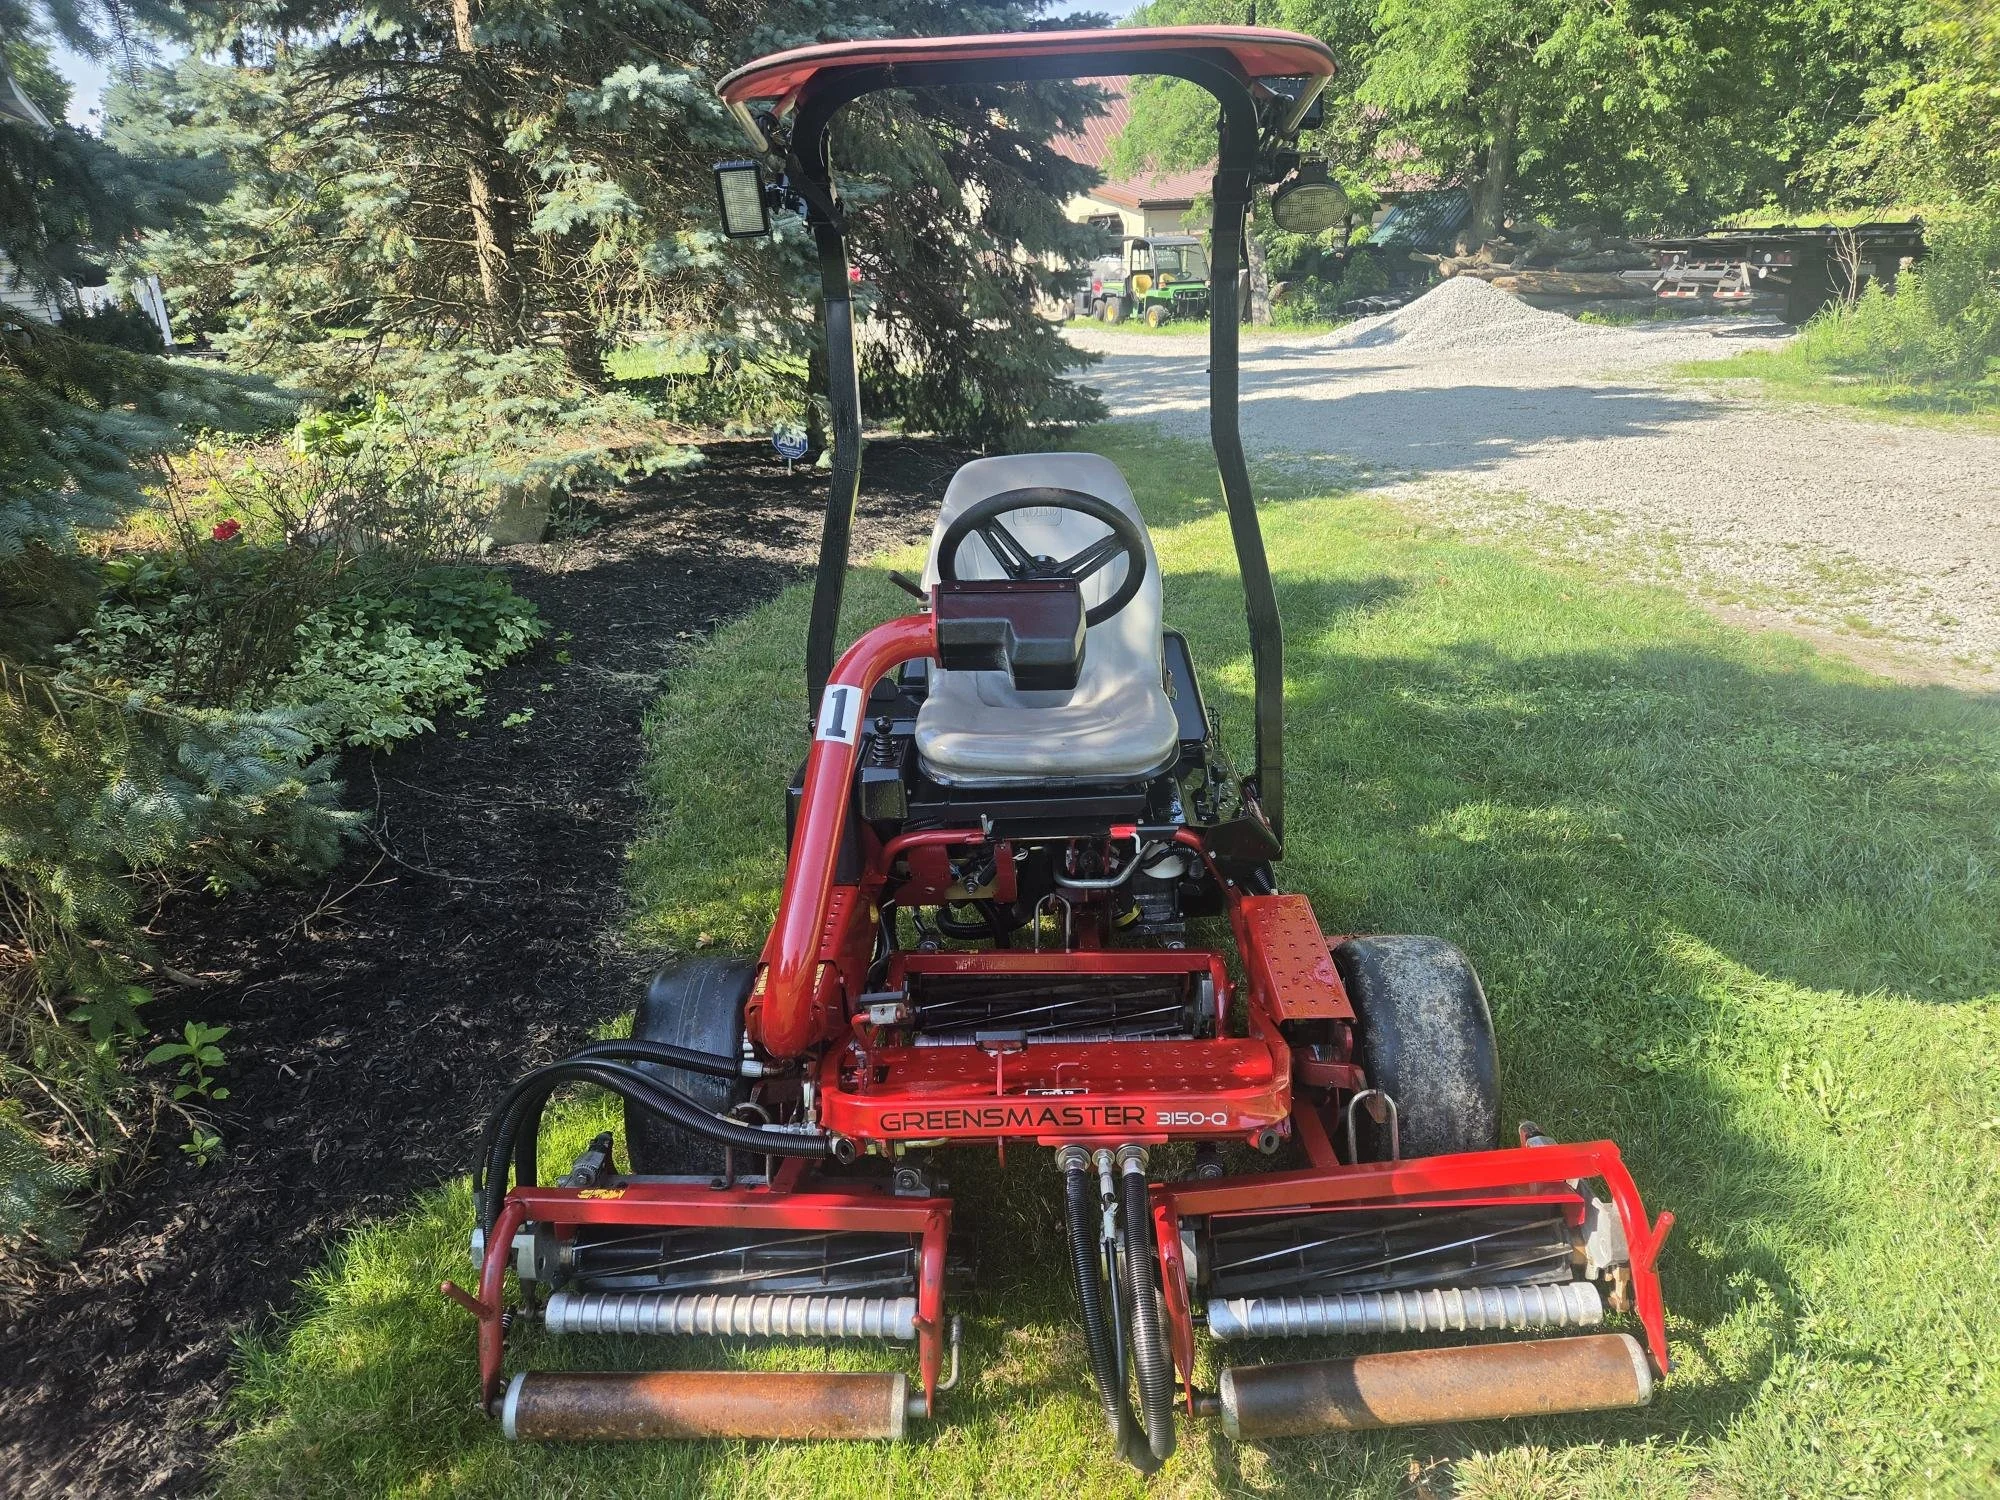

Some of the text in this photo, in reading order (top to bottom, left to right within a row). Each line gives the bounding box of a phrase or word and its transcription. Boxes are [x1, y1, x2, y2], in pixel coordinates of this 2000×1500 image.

[779, 433, 803, 448] ADT
[826, 688, 848, 738] 1
[880, 1107, 1228, 1132] GREENSMASTER 3150-Q
